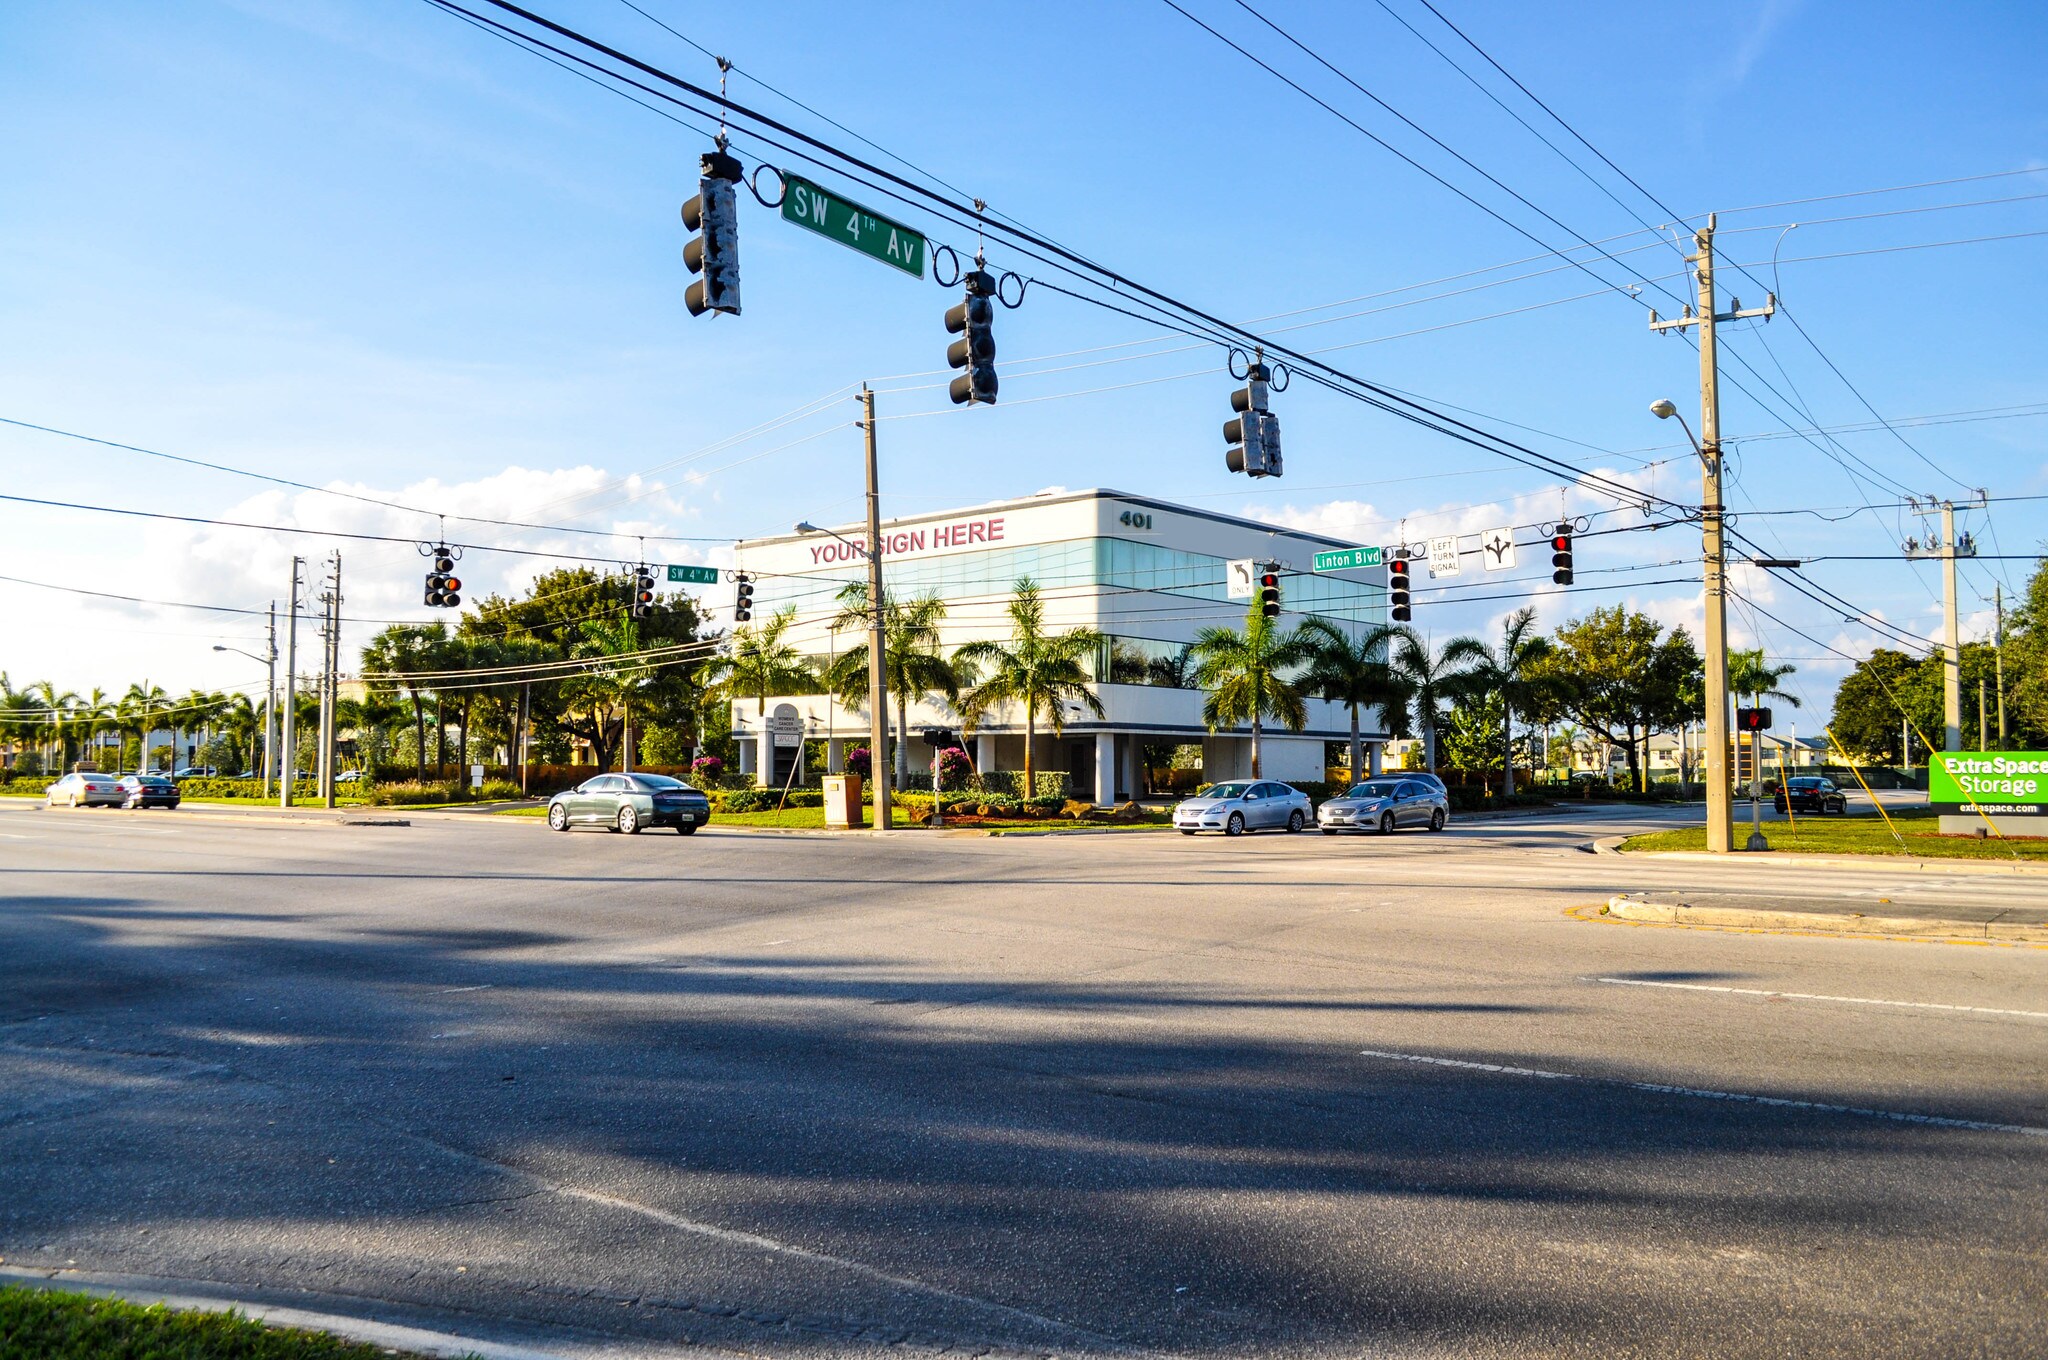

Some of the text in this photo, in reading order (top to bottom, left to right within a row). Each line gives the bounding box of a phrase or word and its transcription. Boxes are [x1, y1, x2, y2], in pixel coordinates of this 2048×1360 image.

[795, 186, 828, 226] SW
[1120, 510, 1152, 530] 401
[810, 539, 866, 565] YOUR
[933, 518, 1005, 549] HERE
[1432, 541, 1452, 551] LEFT
[1315, 550, 1379, 569] Linton Blvd
[1433, 552, 1454, 561] TURN
[671, 567, 684, 580] SW
[1431, 562, 1458, 572] SIGNAL
[1231, 585, 1250, 594] ONLY
[1960, 775, 2037, 797] Storage
